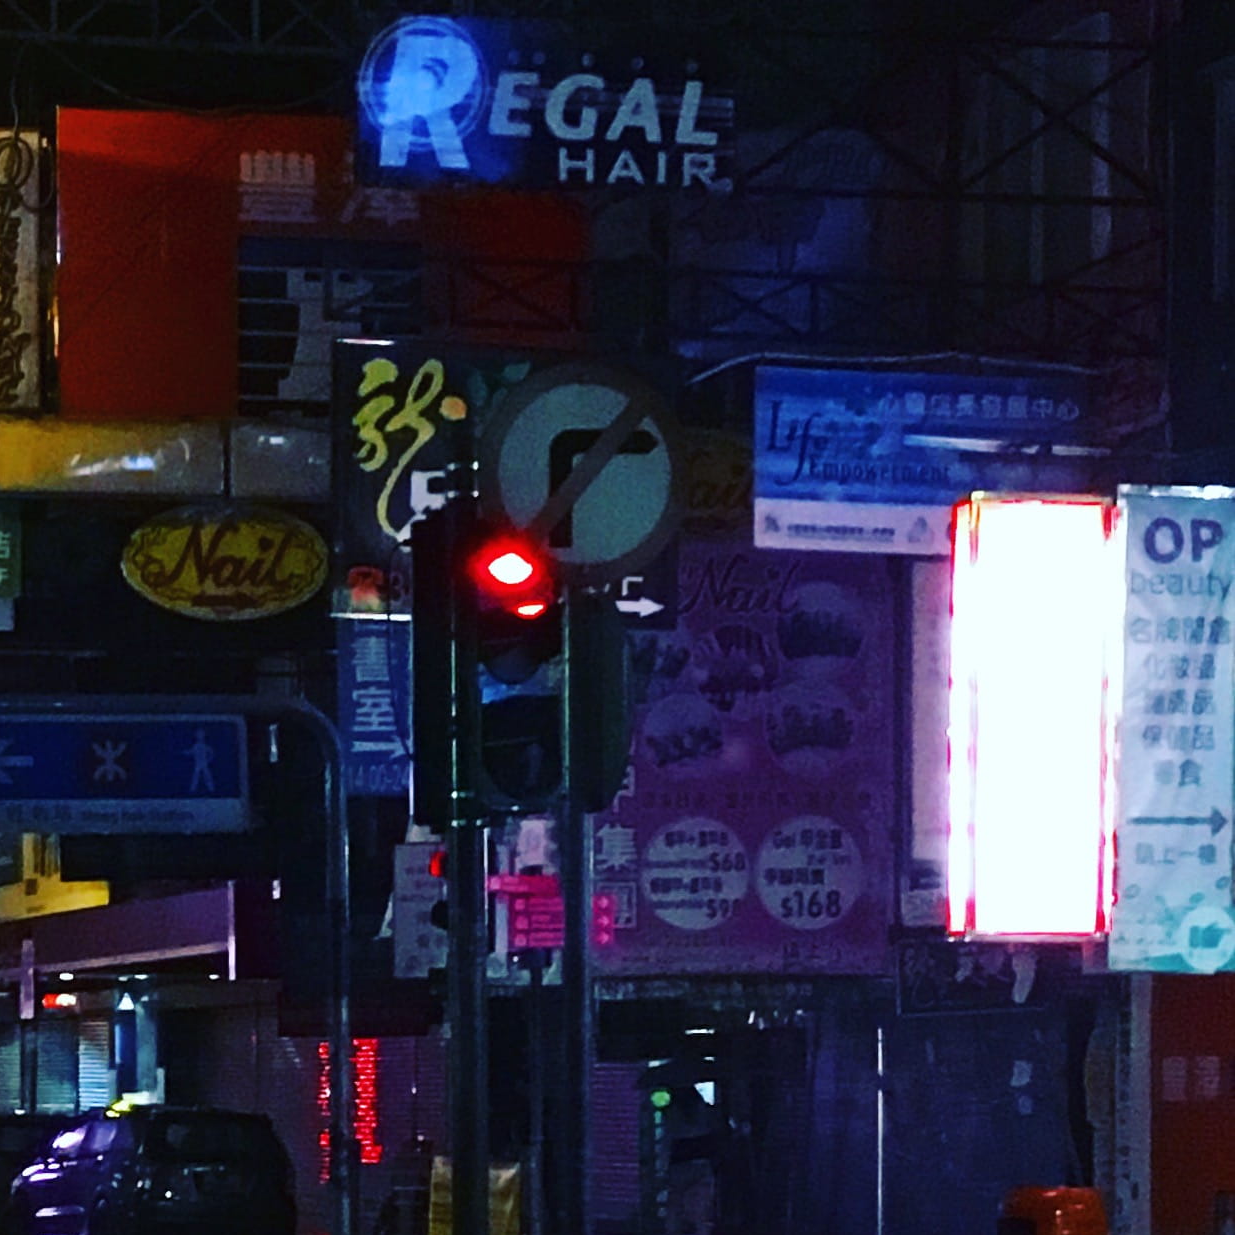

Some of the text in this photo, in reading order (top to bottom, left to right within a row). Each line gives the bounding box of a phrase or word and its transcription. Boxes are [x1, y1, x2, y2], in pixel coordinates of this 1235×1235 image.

[377, 28, 720, 169] REGAL
[558, 146, 718, 188] HAIR
[141, 512, 308, 590] Nail
[1143, 516, 1225, 565] OP
[780, 889, 842, 919] $168
